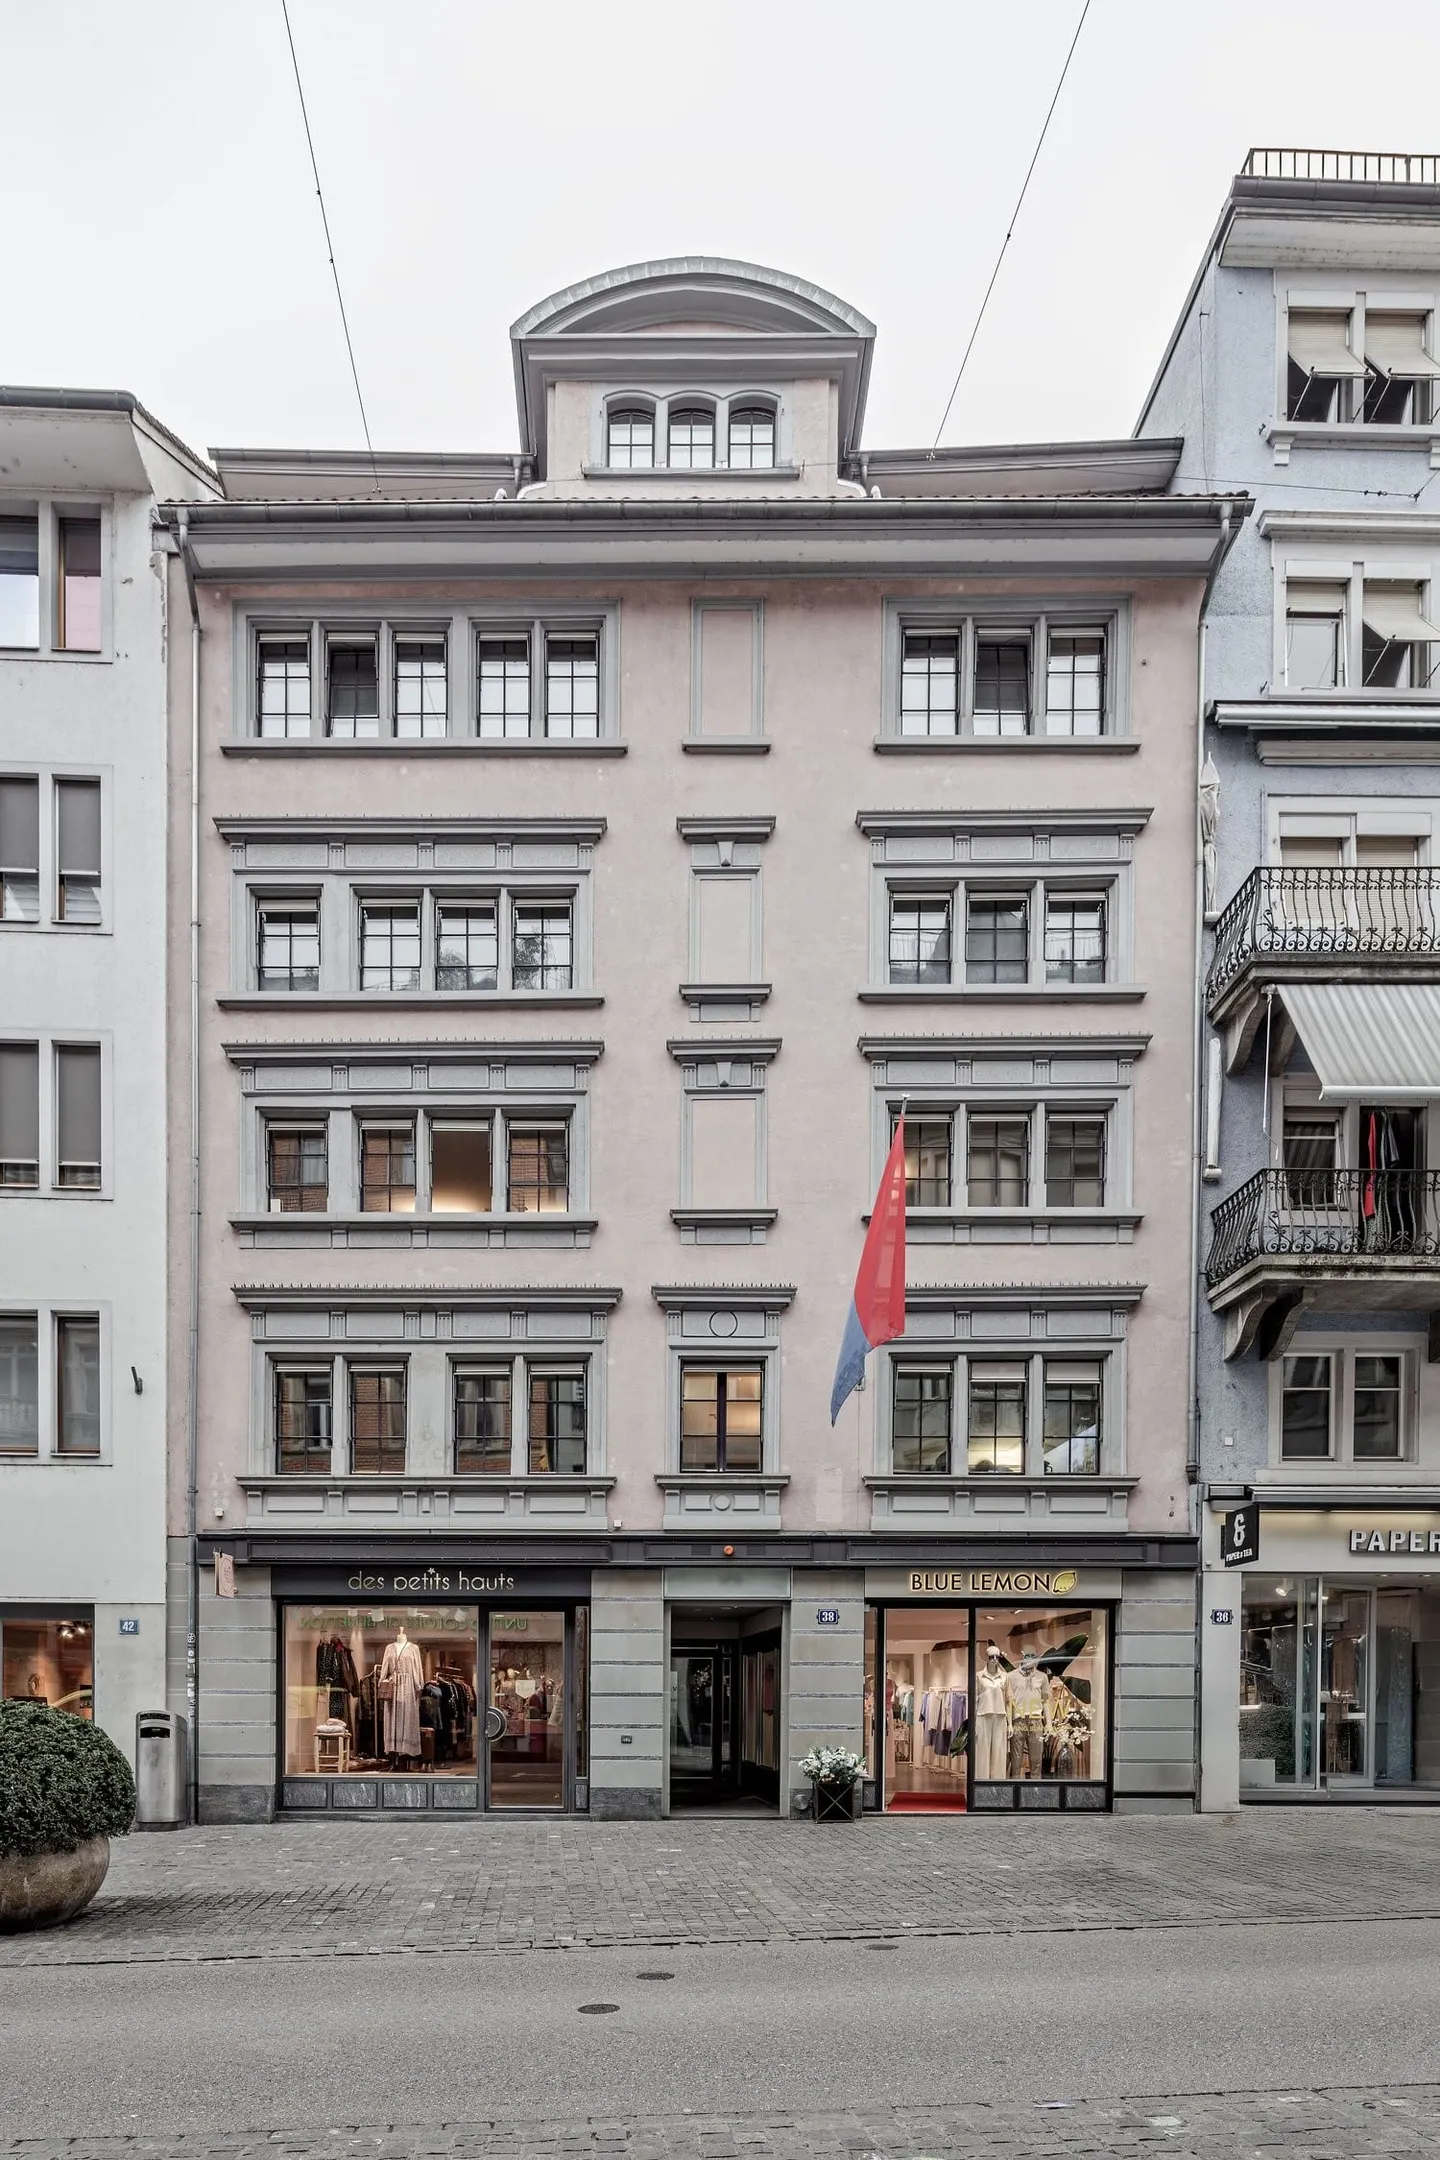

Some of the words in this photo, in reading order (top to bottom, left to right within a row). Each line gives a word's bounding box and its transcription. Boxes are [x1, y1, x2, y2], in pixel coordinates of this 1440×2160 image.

[1350, 1529, 1440, 1552] PAPER
[348, 1570, 384, 1590] des
[394, 1568, 450, 1594] petits
[459, 1571, 514, 1590] hauts
[911, 1573, 962, 1591] BLUE
[971, 1573, 1050, 1591] LEMON
[822, 1611, 834, 1622] 38
[1216, 1612, 1228, 1622] 36
[122, 1621, 135, 1632] 42
[1009, 1698, 1071, 1720] NEW
